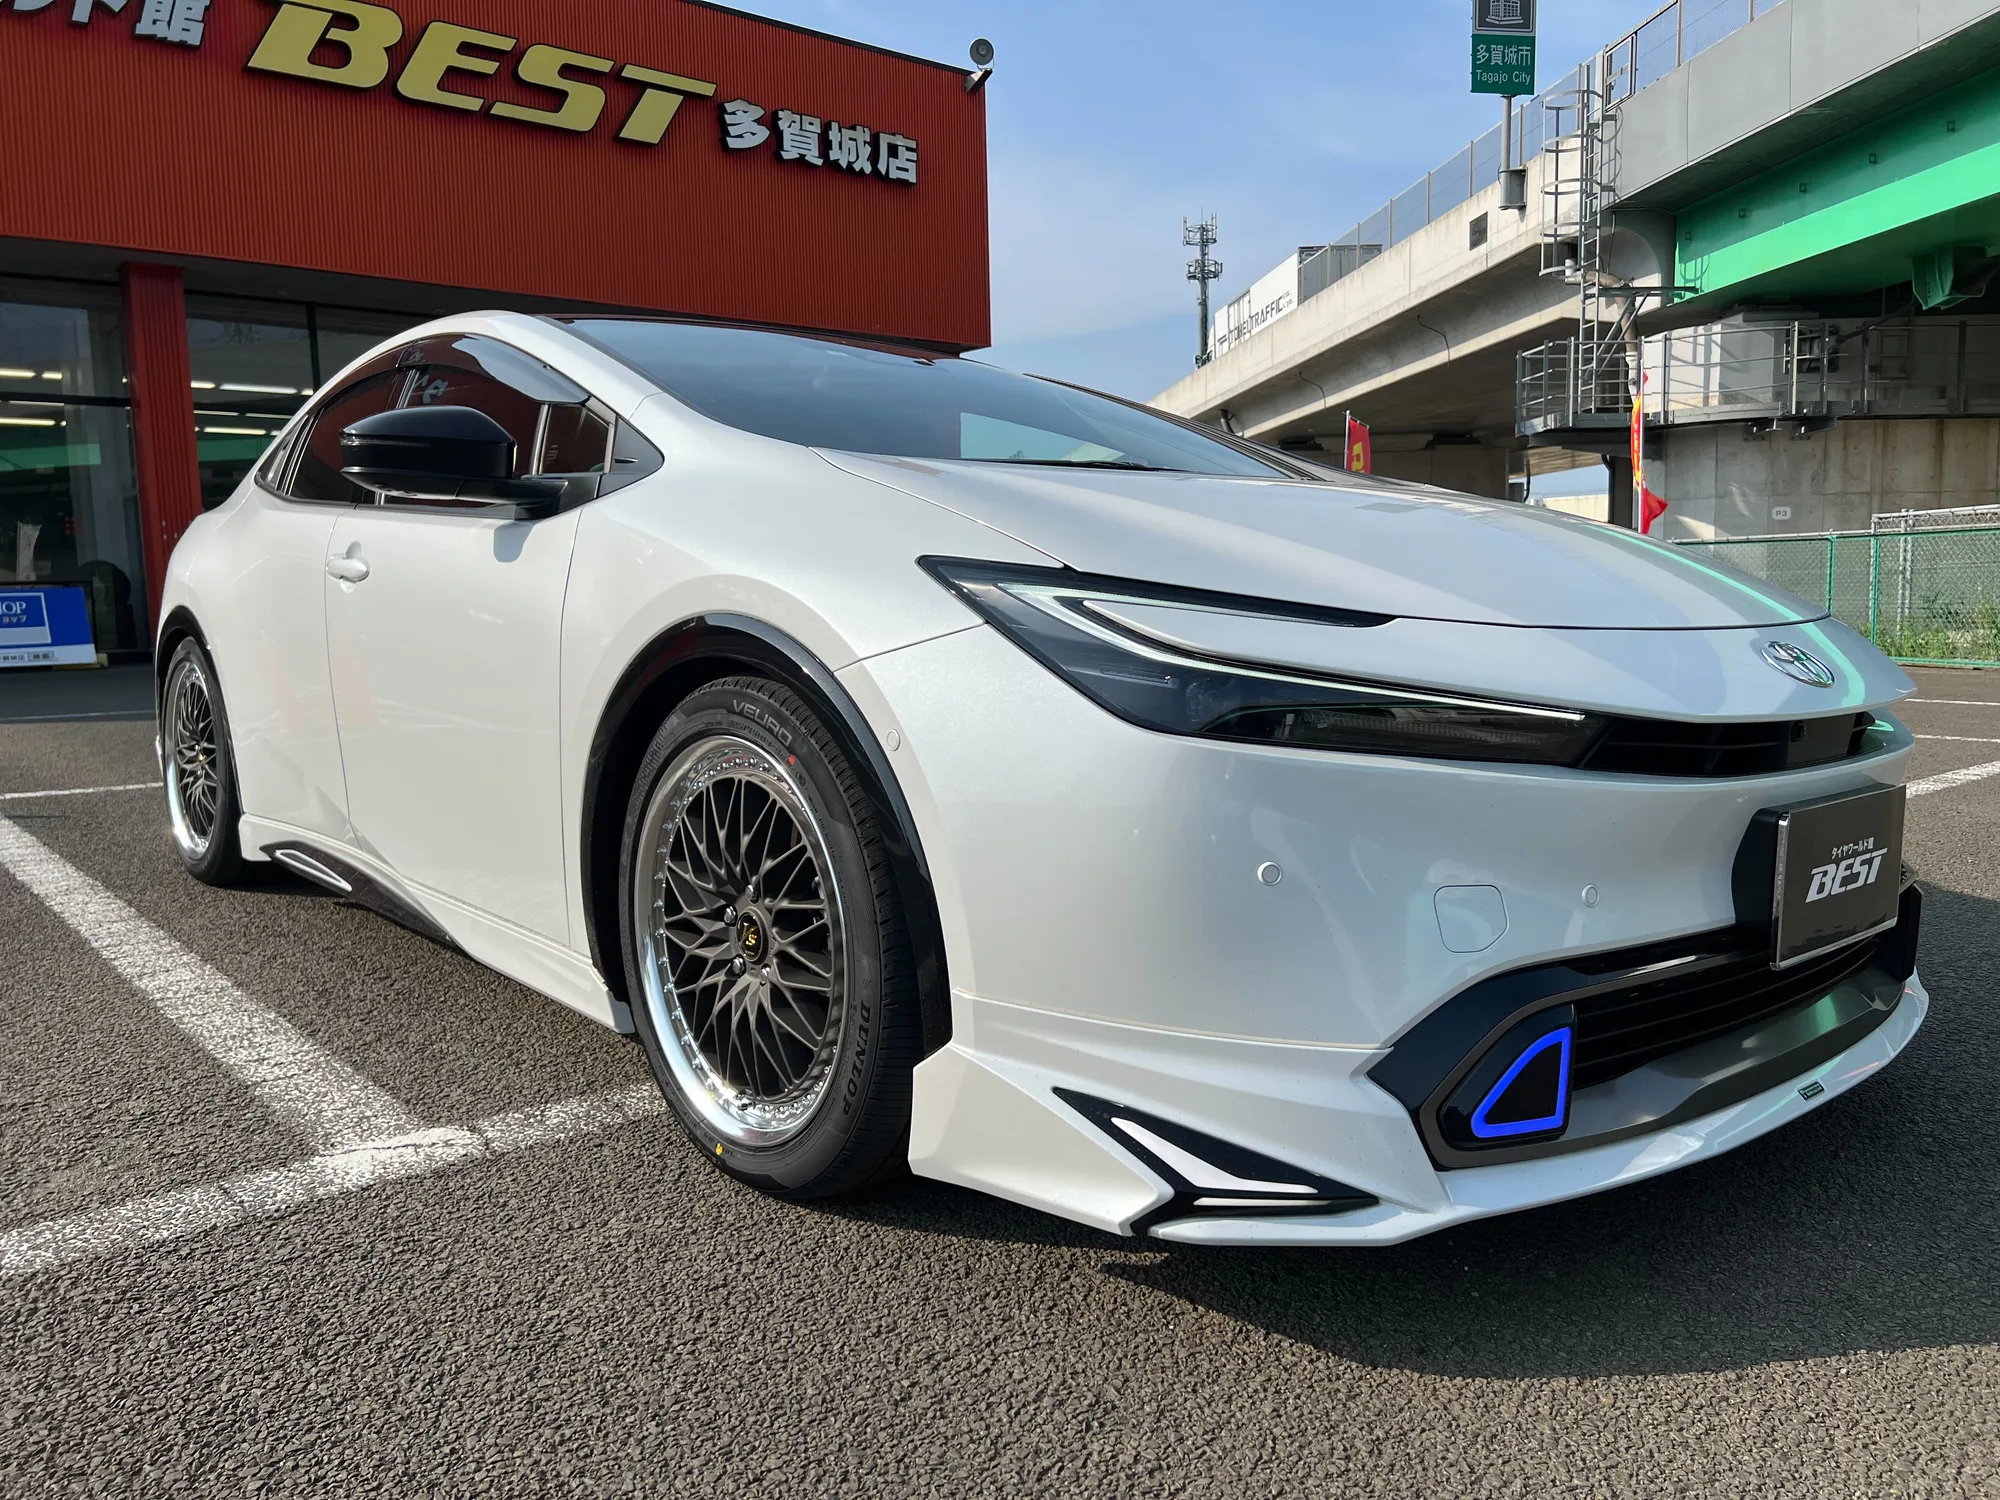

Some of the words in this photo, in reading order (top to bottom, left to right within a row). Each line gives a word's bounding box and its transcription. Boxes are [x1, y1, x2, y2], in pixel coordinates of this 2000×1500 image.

[1476, 44, 1532, 66] 多賀城市
[1476, 69, 1508, 84] Tagajo
[1512, 71, 1531, 85] City
[248, 0, 717, 145] BEST
[723, 98, 918, 184] 多賀城店
[1250, 296, 1283, 330] TRAFFIC
[733, 699, 793, 747] VEURO
[1805, 848, 1888, 903] BEST
[843, 1001, 870, 1116] DUNLOP
